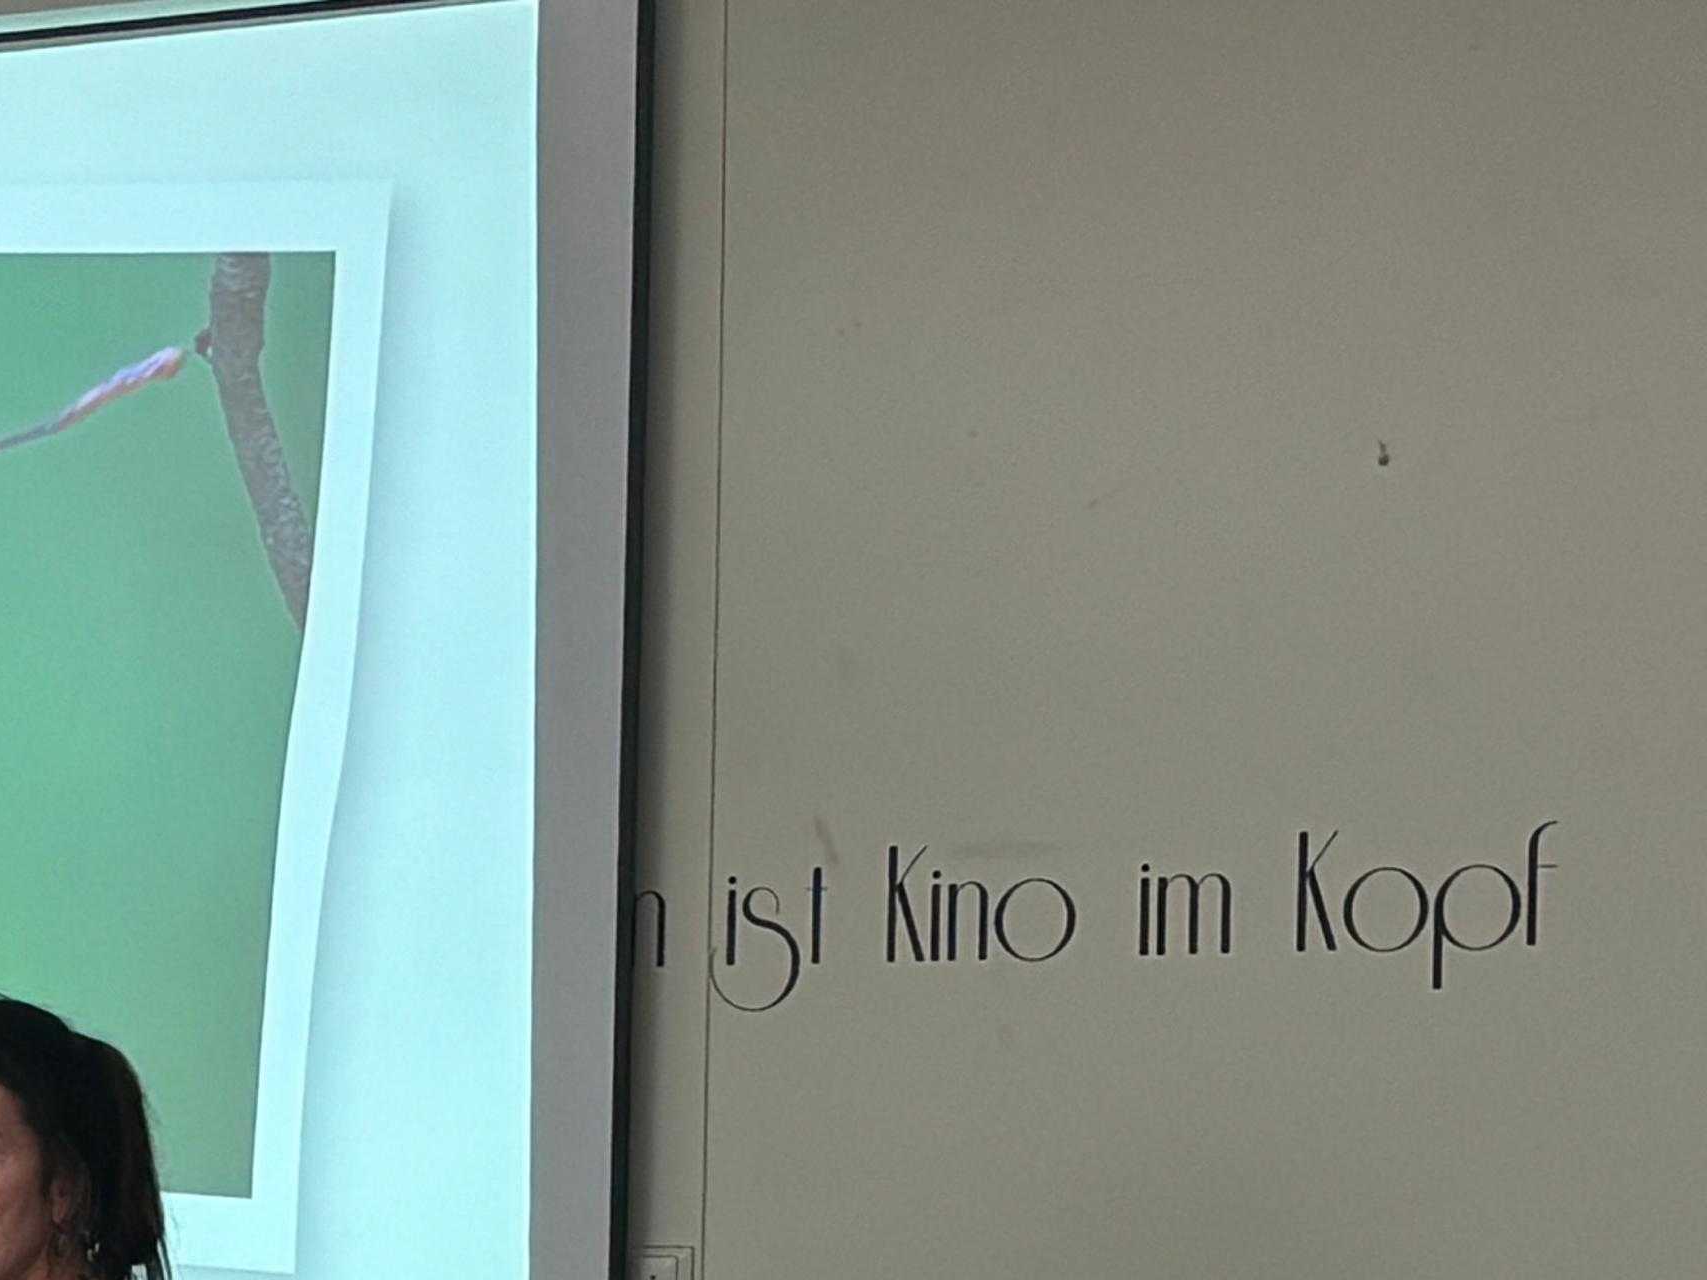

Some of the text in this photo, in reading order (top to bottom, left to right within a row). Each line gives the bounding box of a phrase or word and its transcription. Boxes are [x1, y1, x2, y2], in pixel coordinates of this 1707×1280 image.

[708, 866, 828, 1013] ist
[886, 845, 1077, 963] Kino
[1137, 863, 1232, 957] im
[1296, 820, 1559, 991] Kopf
